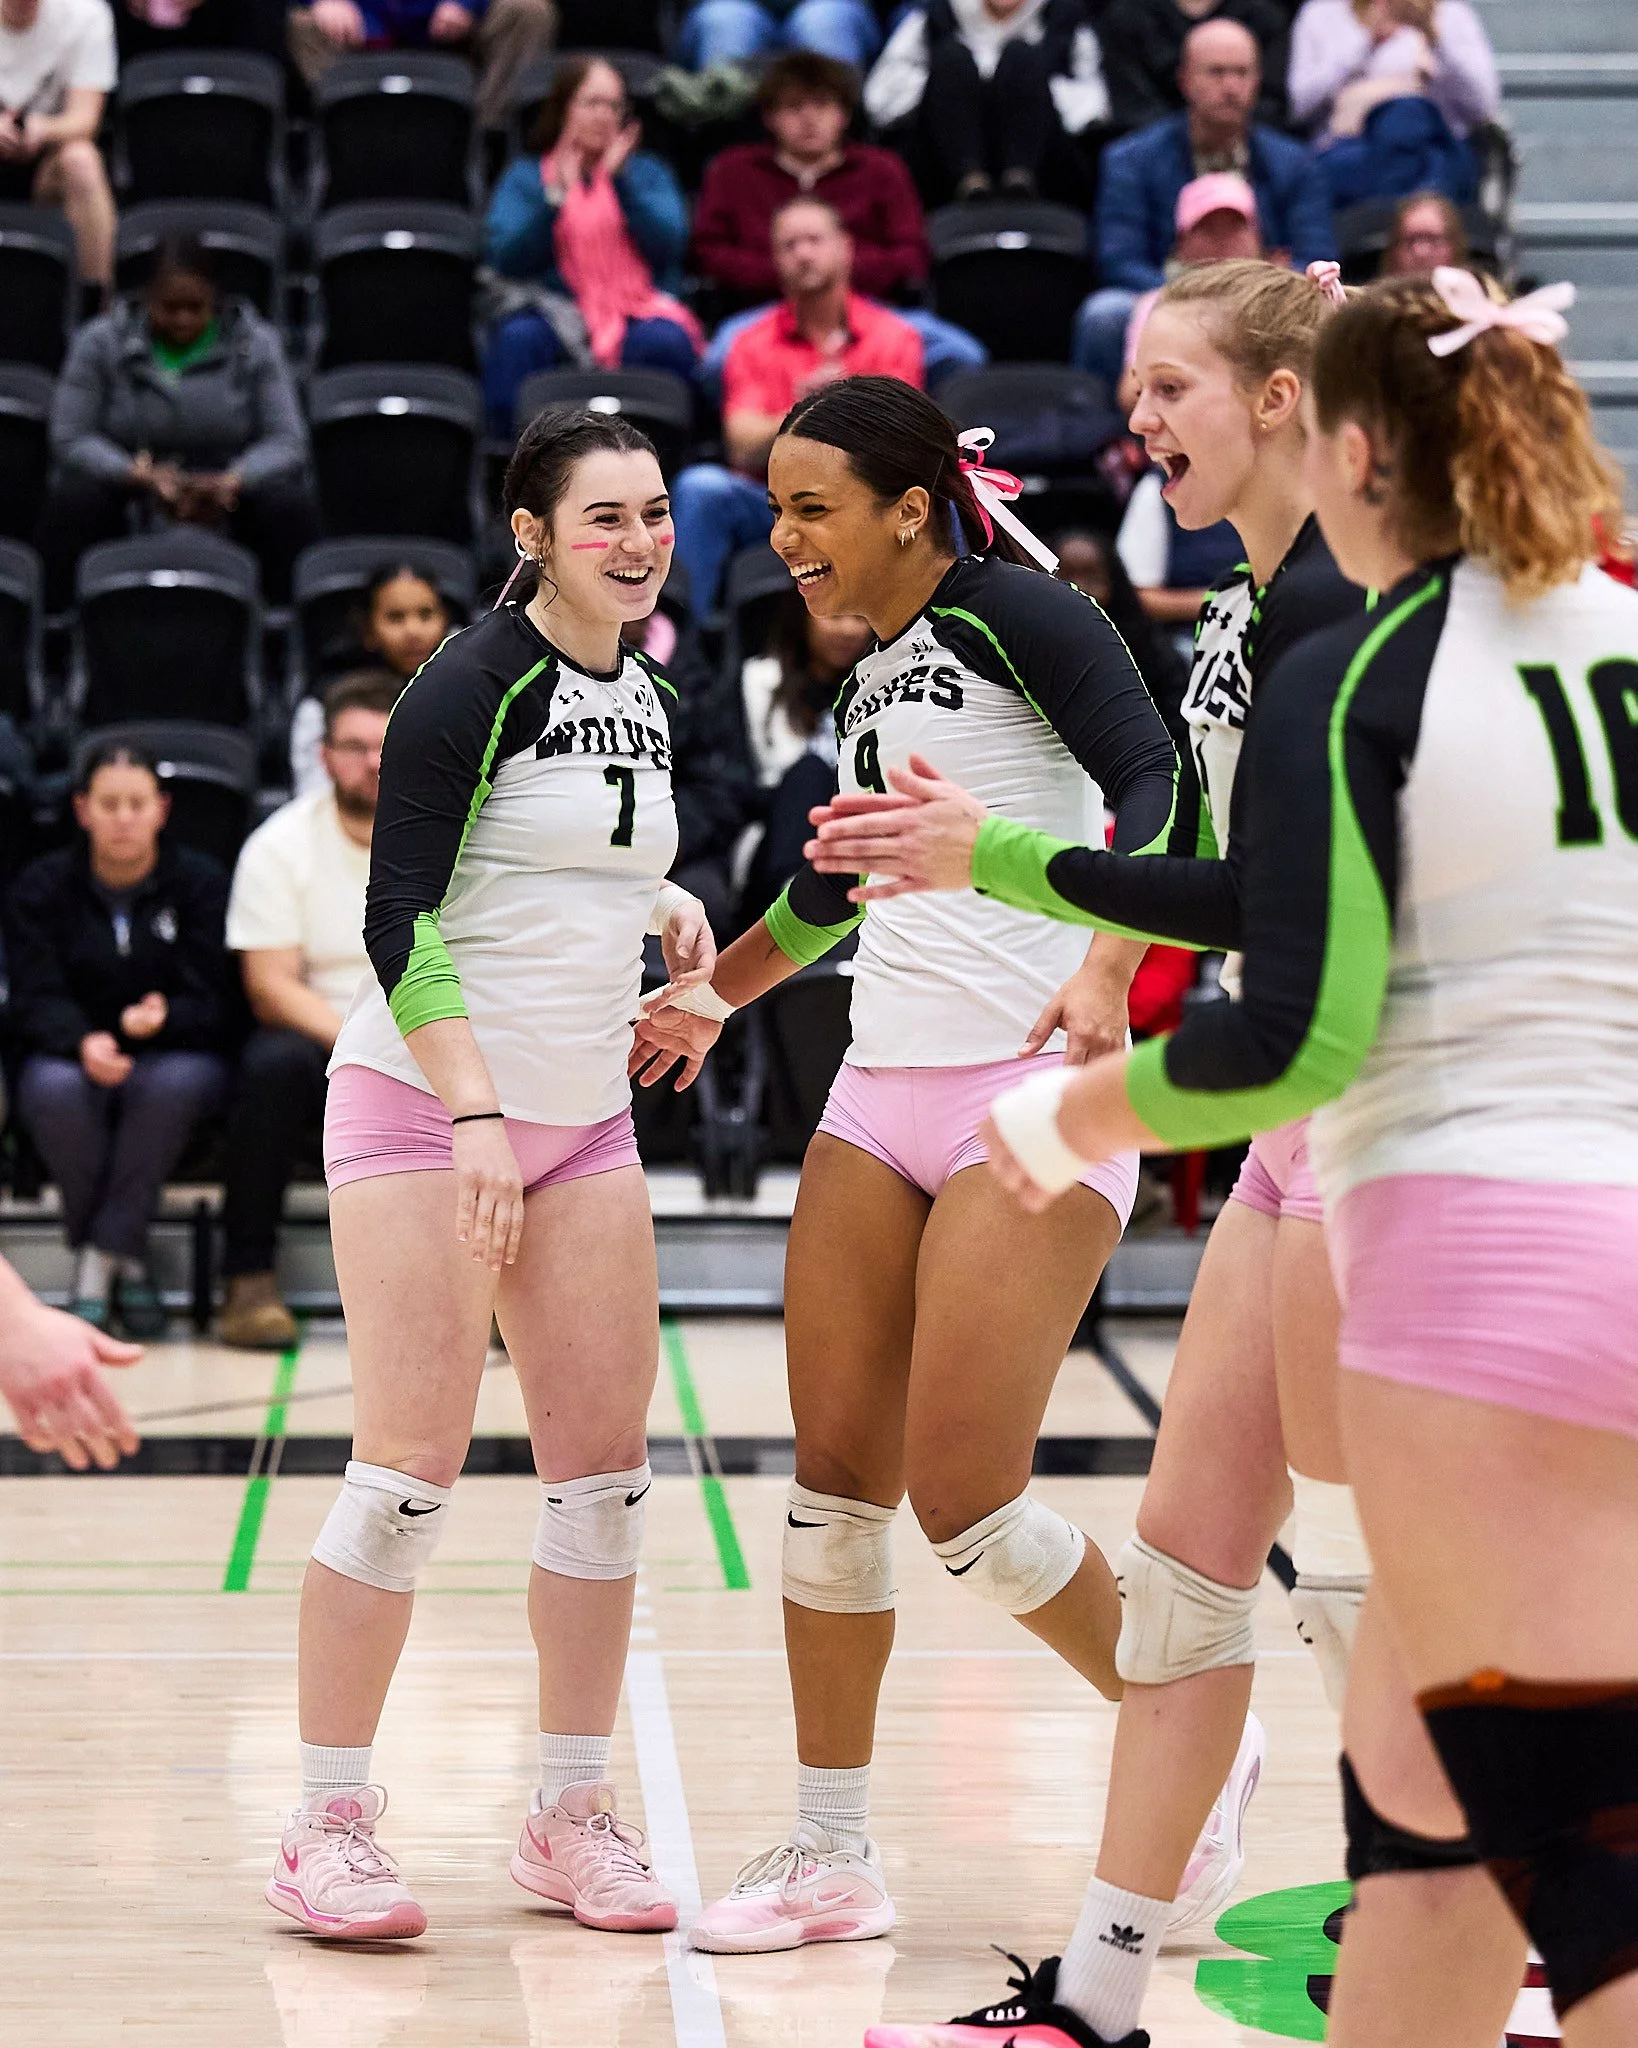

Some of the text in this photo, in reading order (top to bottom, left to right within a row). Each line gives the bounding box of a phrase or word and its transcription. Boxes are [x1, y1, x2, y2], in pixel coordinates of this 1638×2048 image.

[847, 666, 964, 731] LVES
[536, 716, 671, 770] WOLVE
[855, 729, 887, 794] 9
[603, 763, 635, 848] 7
[1099, 1934, 1142, 1955] adidas
